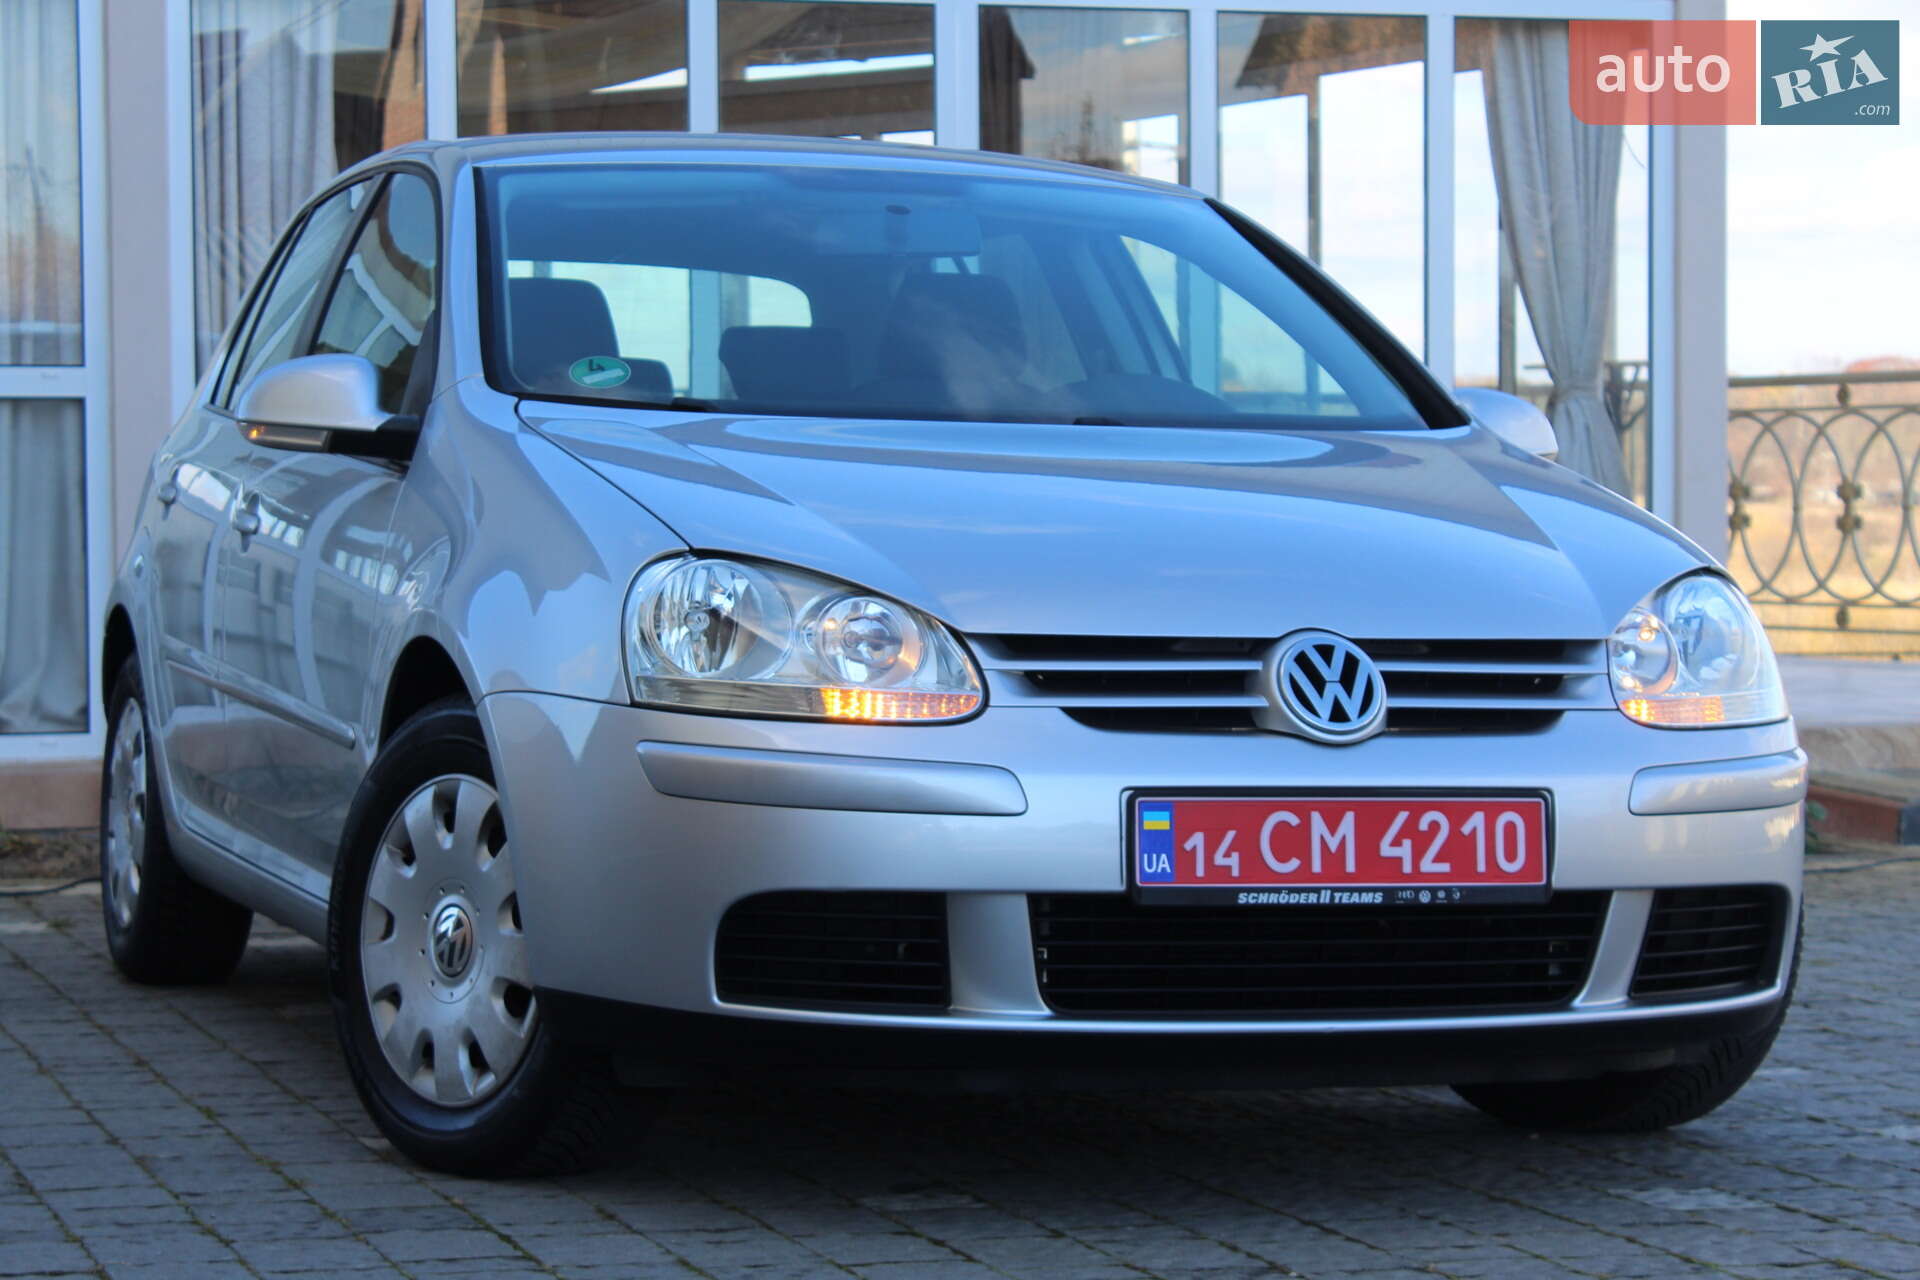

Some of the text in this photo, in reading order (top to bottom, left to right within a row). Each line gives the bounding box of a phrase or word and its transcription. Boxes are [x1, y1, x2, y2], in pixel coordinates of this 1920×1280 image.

[1182, 810, 1527, 878] 14 CM 4210
[1143, 853, 1171, 873] UA
[1237, 890, 1318, 904] SCHRÖDER
[1333, 892, 1383, 904] TEAMS
